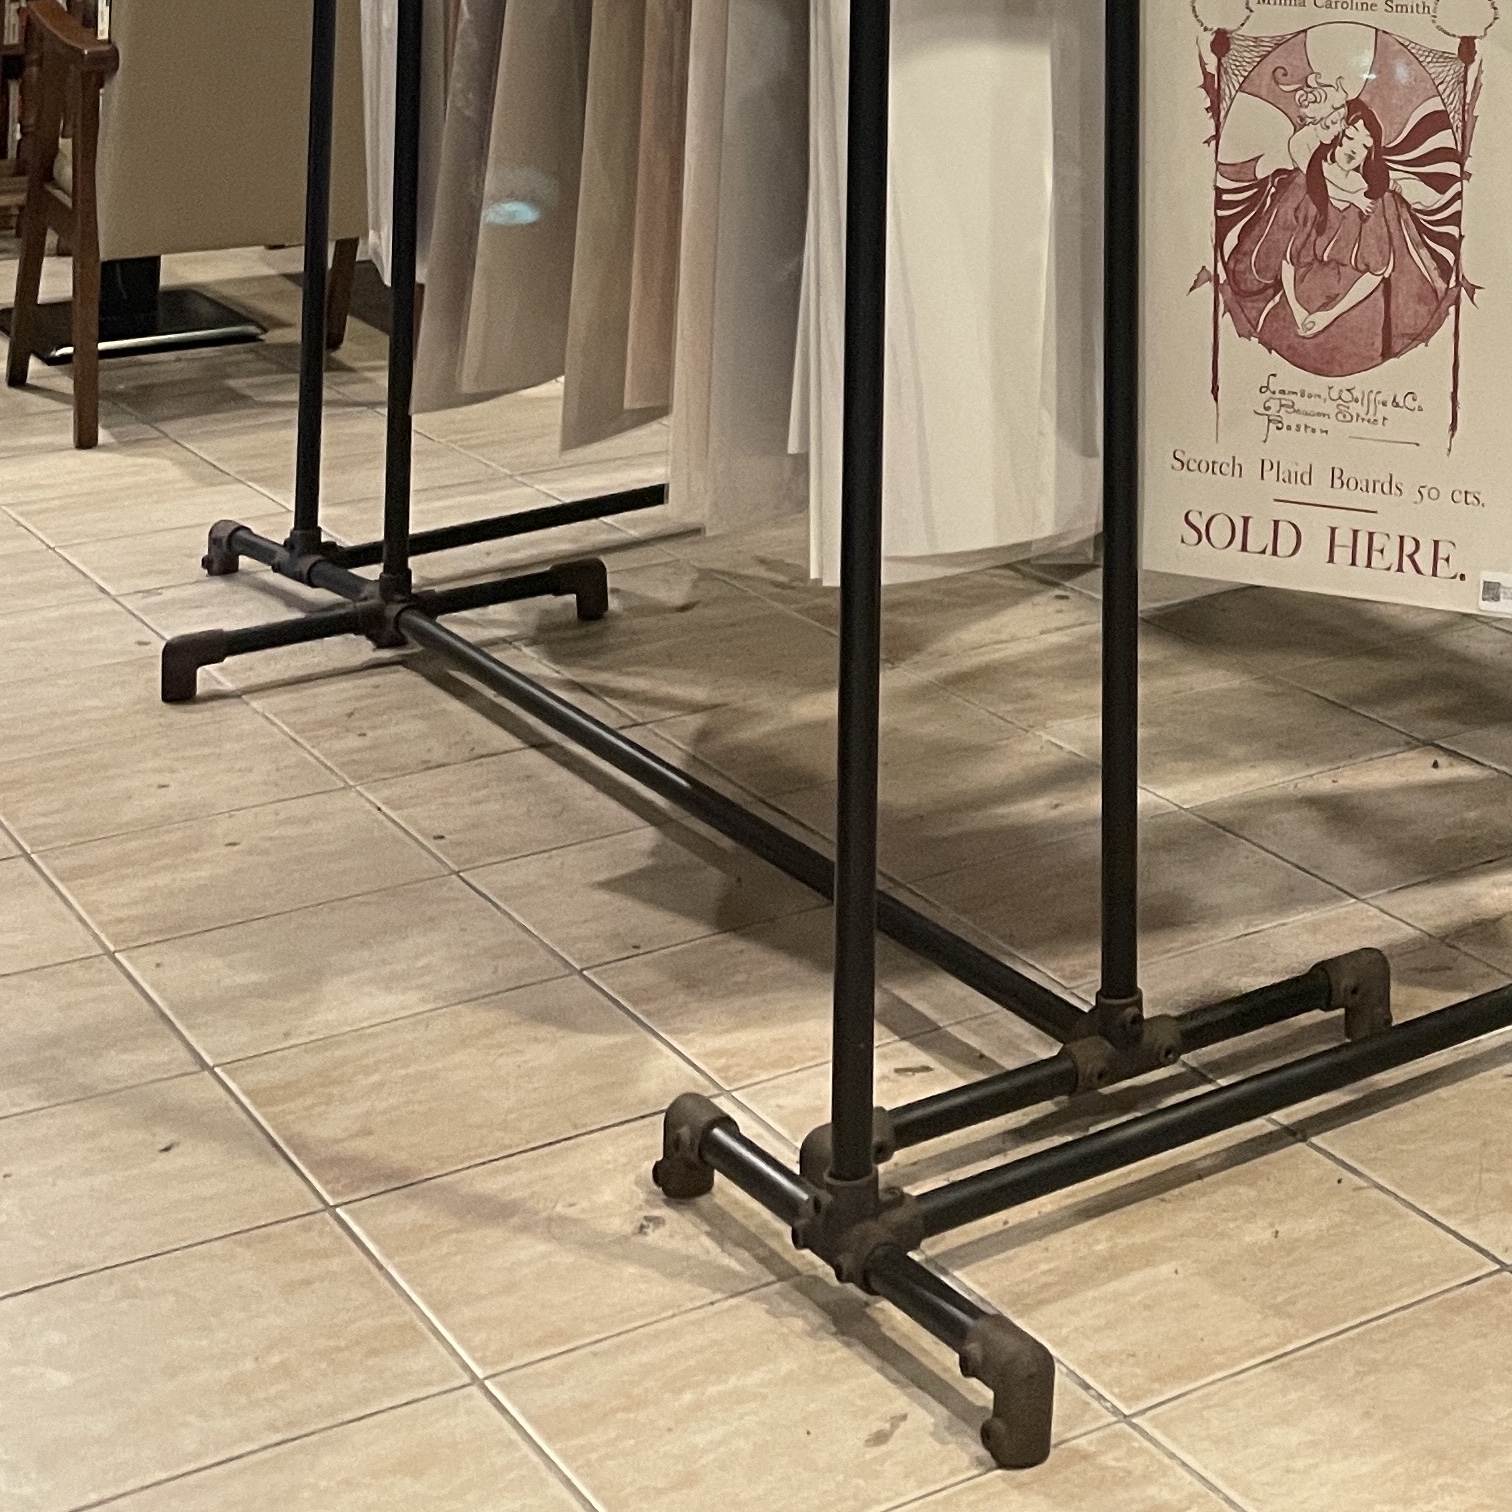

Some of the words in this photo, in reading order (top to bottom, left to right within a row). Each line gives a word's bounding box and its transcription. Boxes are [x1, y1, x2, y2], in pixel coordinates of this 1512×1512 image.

[1335, 403, 1389, 427] Street
[1170, 449, 1244, 479] Scotch
[1259, 457, 1313, 487] Plaid
[1329, 466, 1404, 498] Boards
[1412, 483, 1441, 505] 50
[1450, 487, 1486, 508] cts.
[1180, 508, 1303, 559] SOLD
[1325, 524, 1467, 582] HERE.
